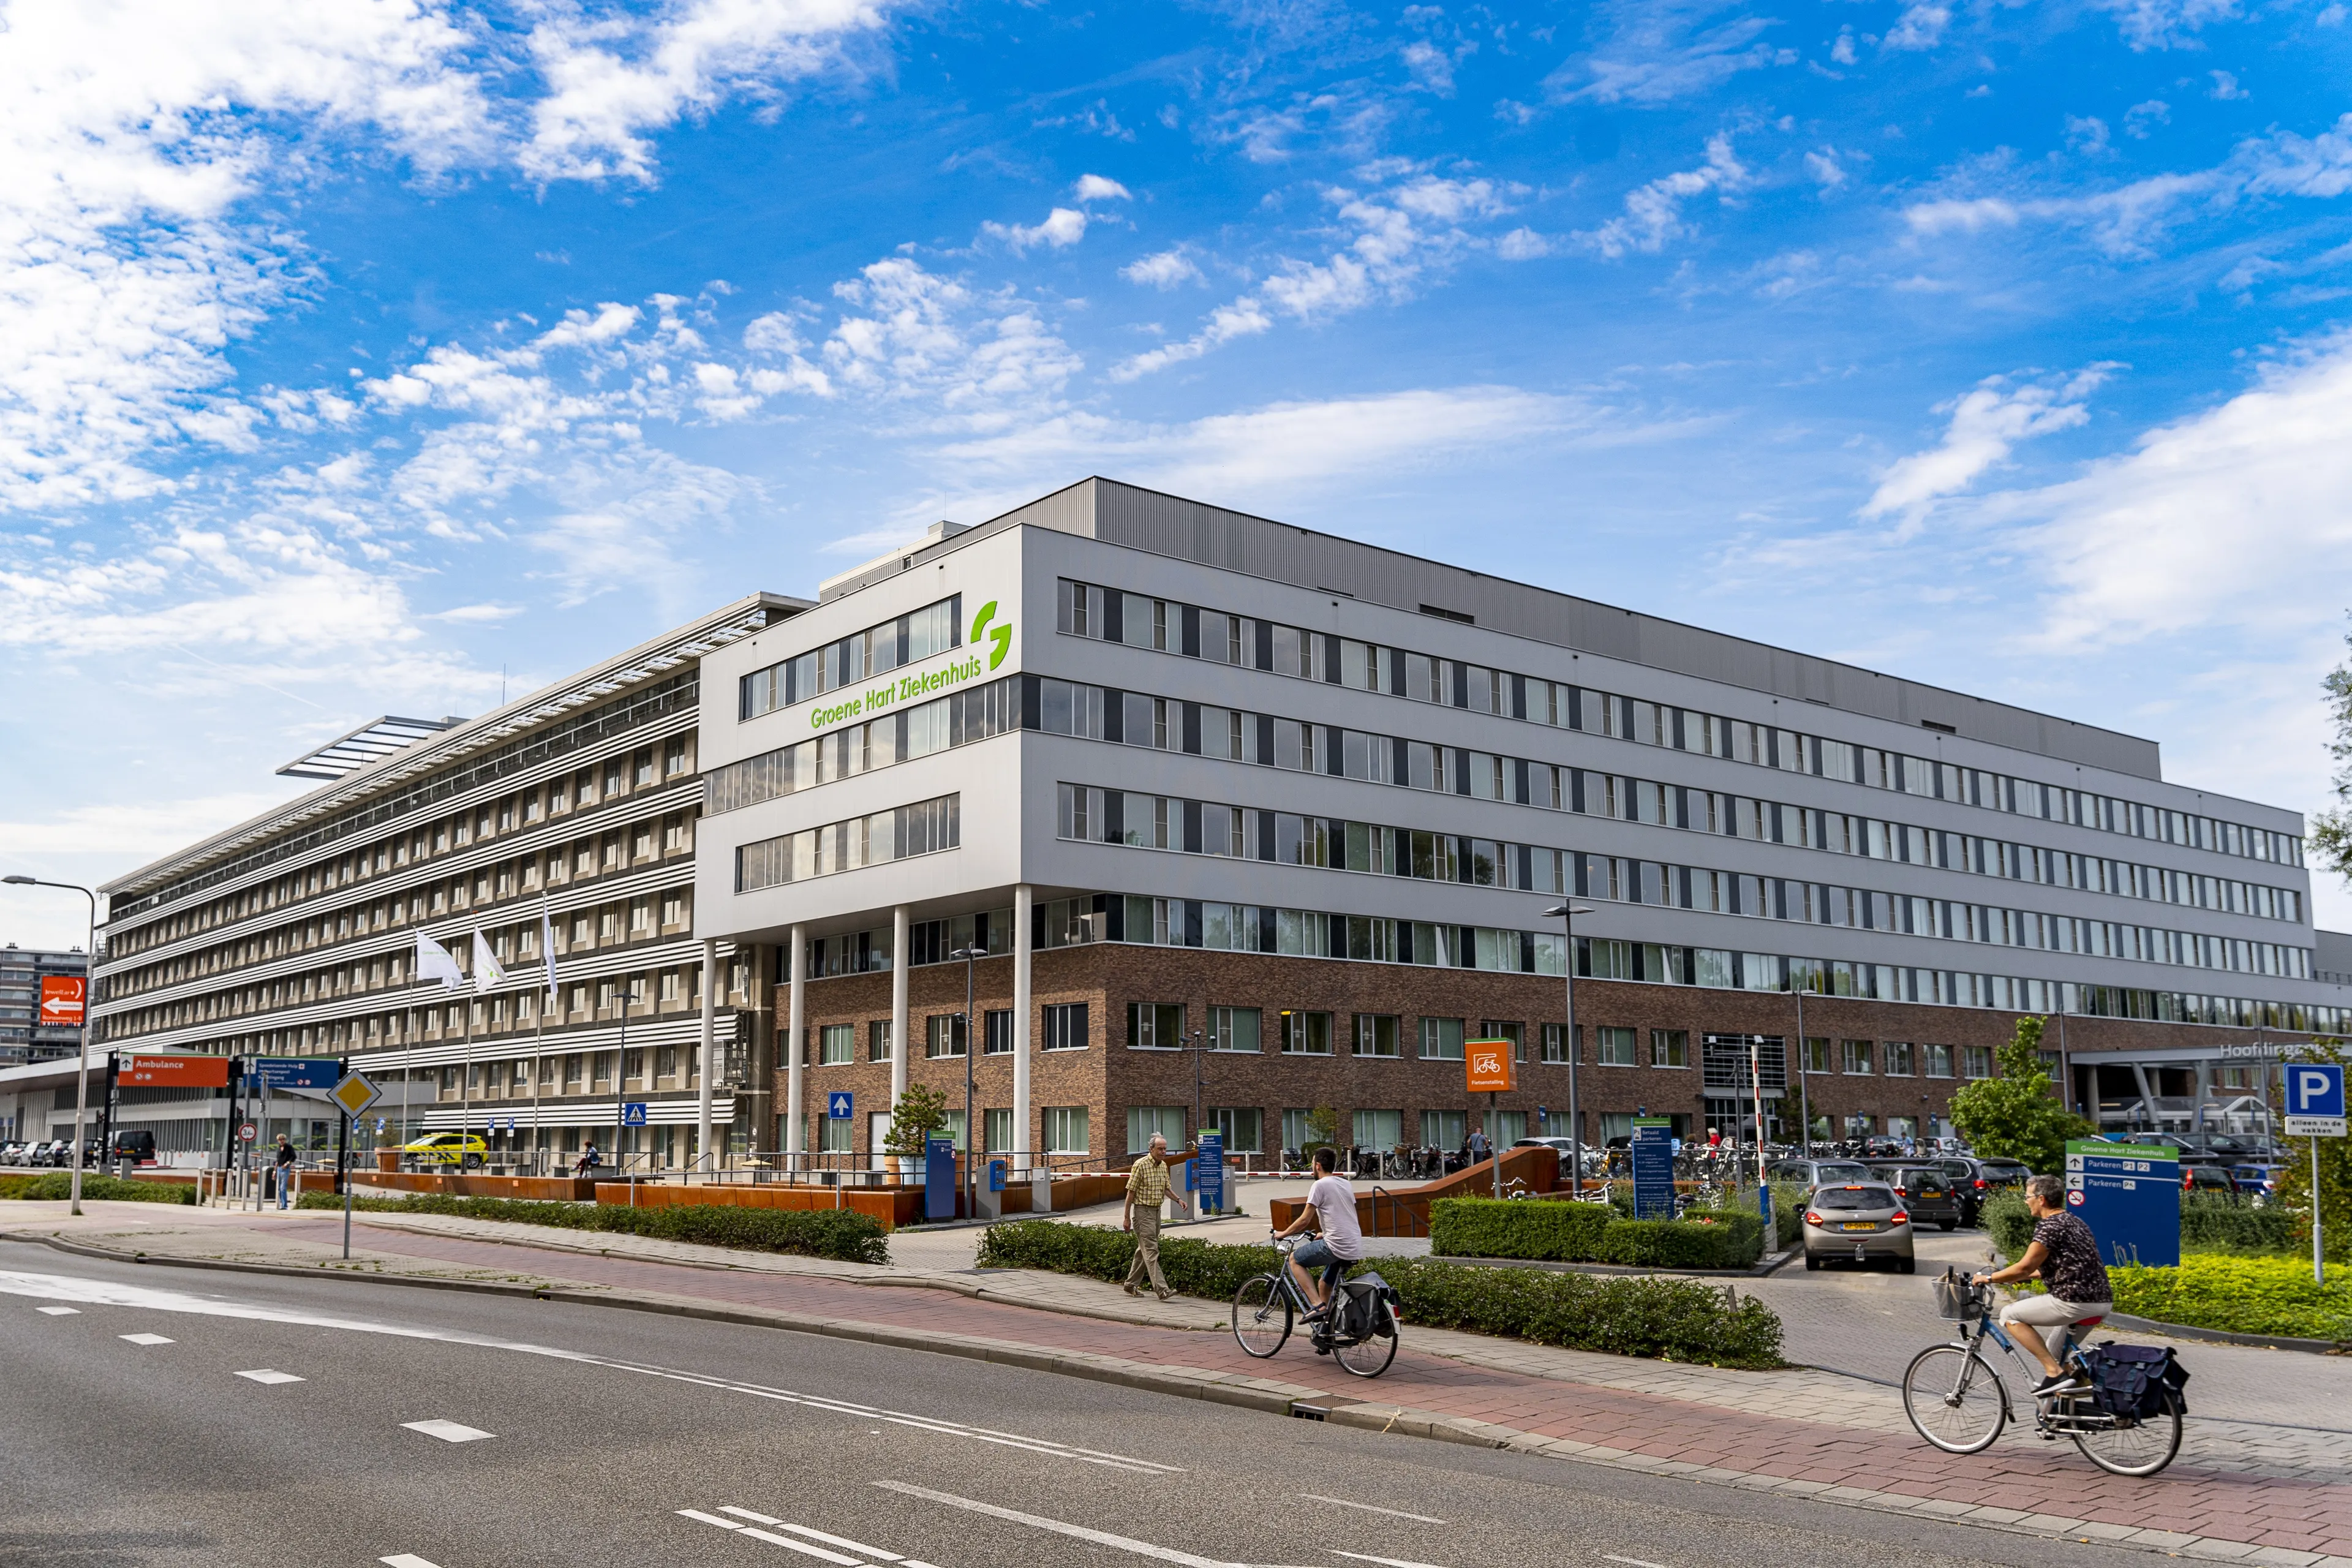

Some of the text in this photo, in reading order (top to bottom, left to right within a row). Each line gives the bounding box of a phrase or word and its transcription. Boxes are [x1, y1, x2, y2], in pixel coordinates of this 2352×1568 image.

[811, 655, 981, 729] Groene Hart Ziekenhuis
[135, 1060, 184, 1068] Ambulance
[2299, 1071, 2331, 1109] P
[2080, 1145, 2108, 1153] Groene
[2126, 1148, 2165, 1156] Ziekenhuis
[2088, 1159, 2122, 1169] Parkeren
[2088, 1178, 2122, 1188] Parkeren
